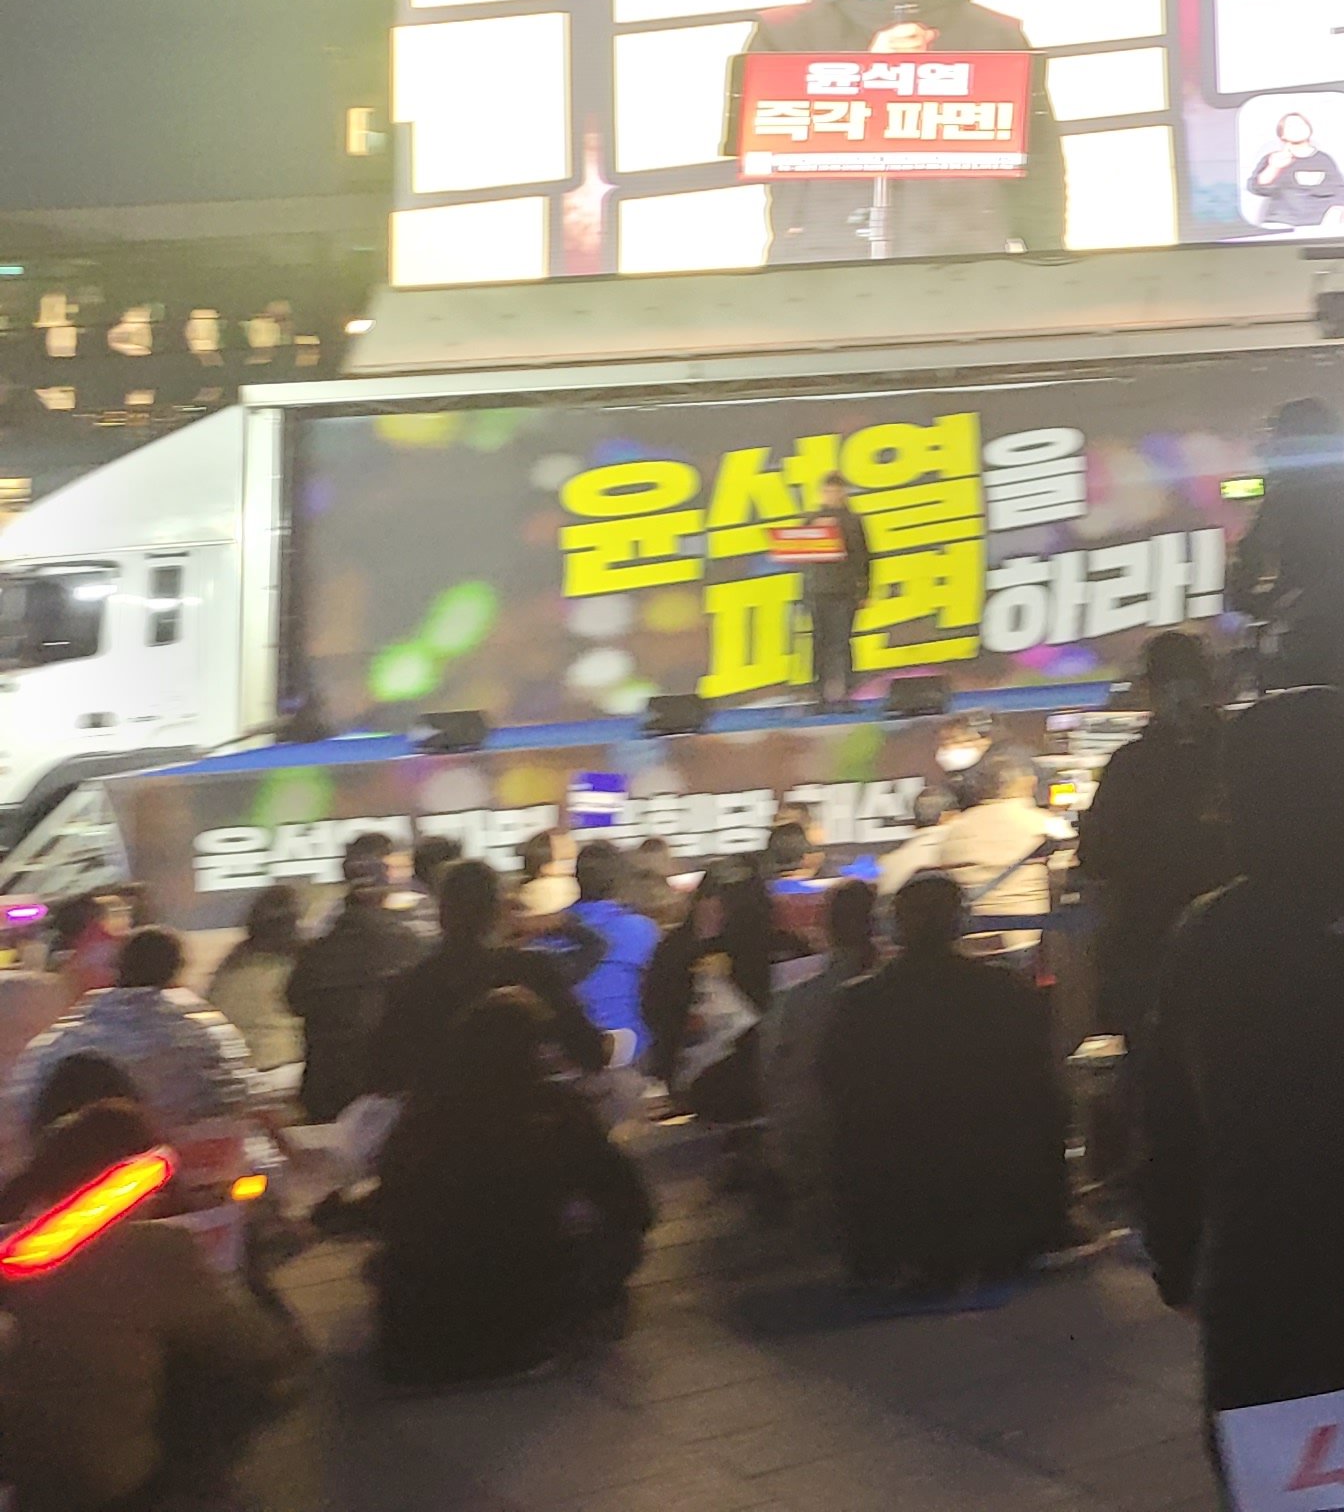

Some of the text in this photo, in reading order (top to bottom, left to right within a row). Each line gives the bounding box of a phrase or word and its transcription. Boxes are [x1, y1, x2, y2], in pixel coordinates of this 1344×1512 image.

[805, 61, 974, 96] 윤석열
[754, 100, 1014, 141] 즉각 파면!
